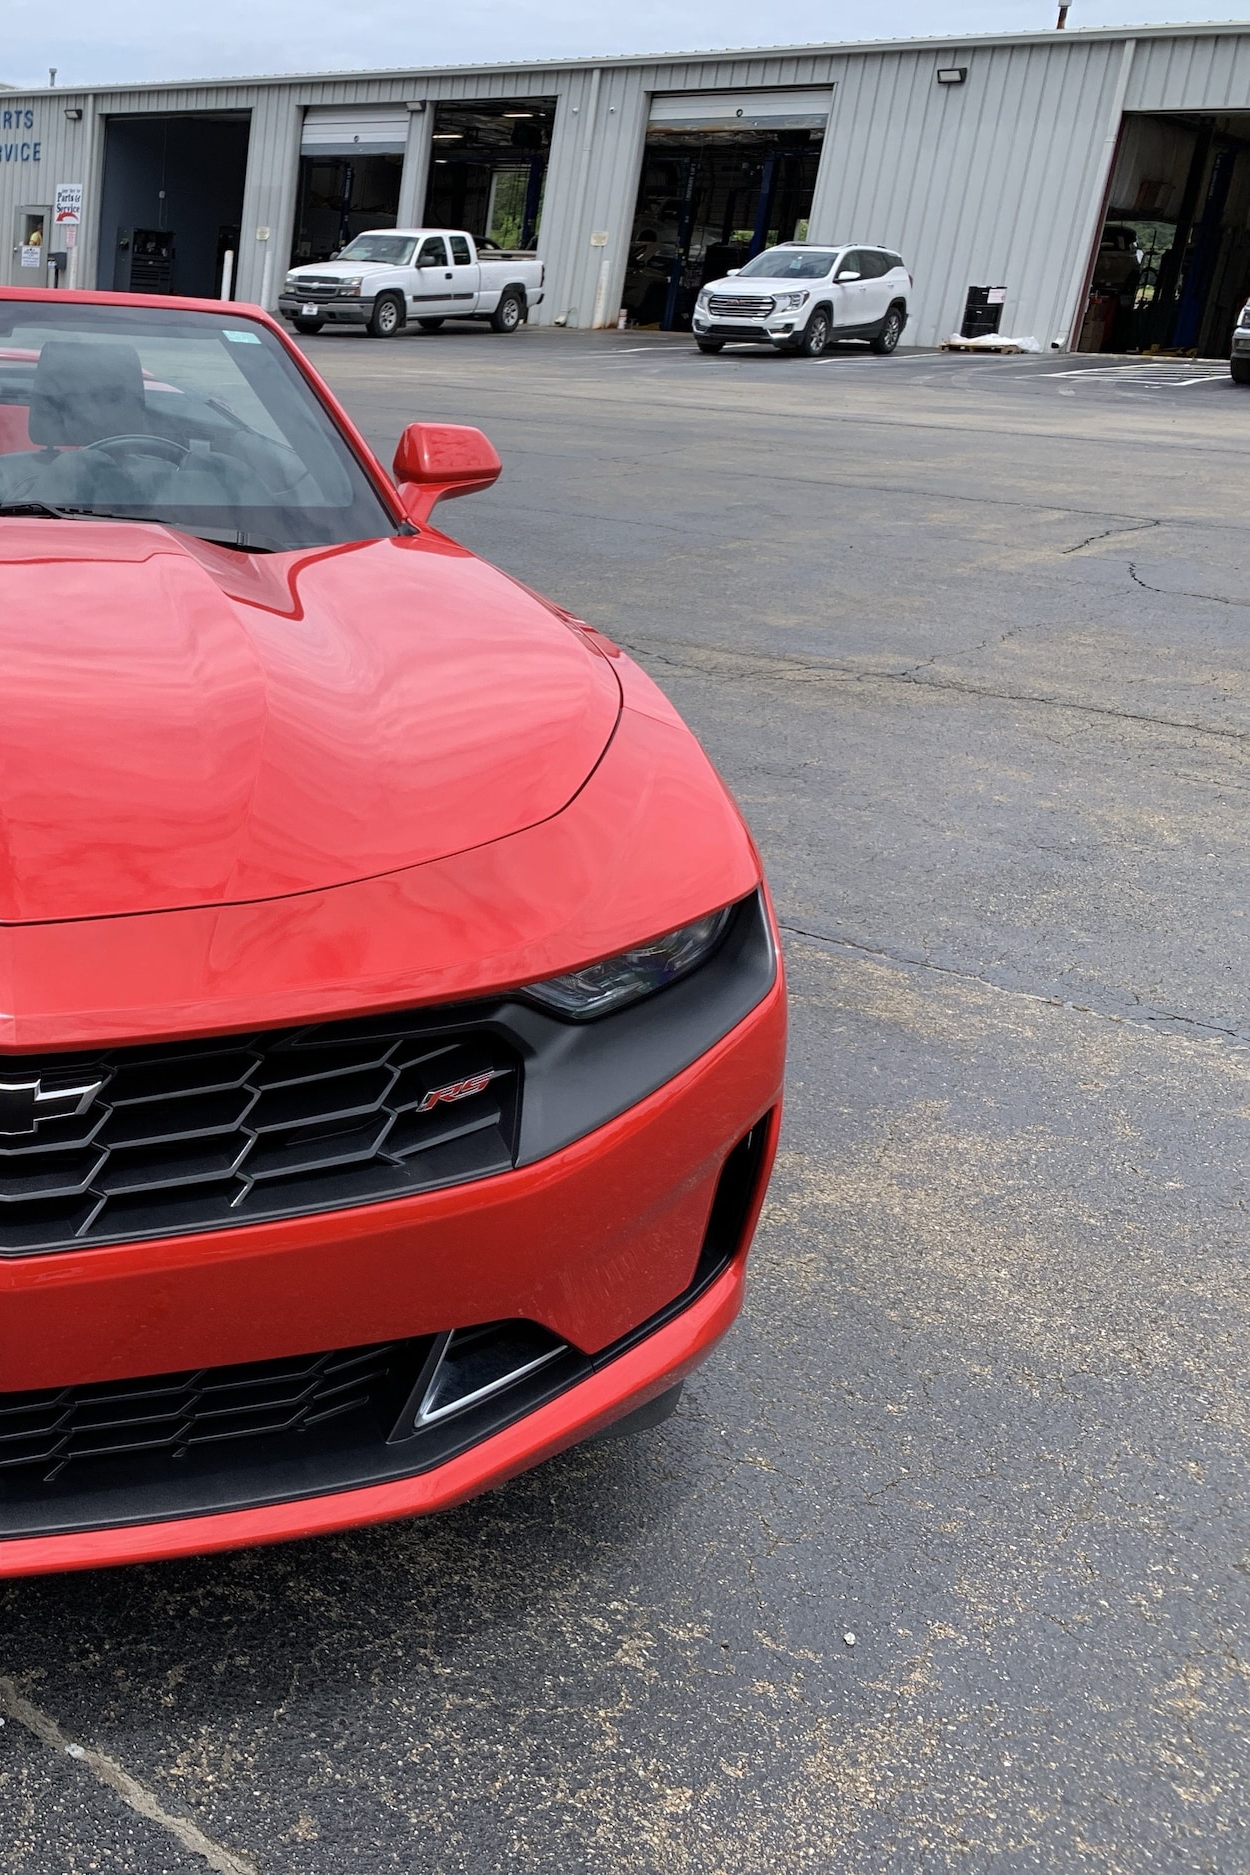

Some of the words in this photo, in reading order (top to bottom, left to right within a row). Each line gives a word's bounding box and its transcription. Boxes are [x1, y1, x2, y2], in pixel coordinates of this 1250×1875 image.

[57, 192, 74, 202] Parts
[56, 203, 80, 213] Service
[416, 1070, 495, 1113] RS
